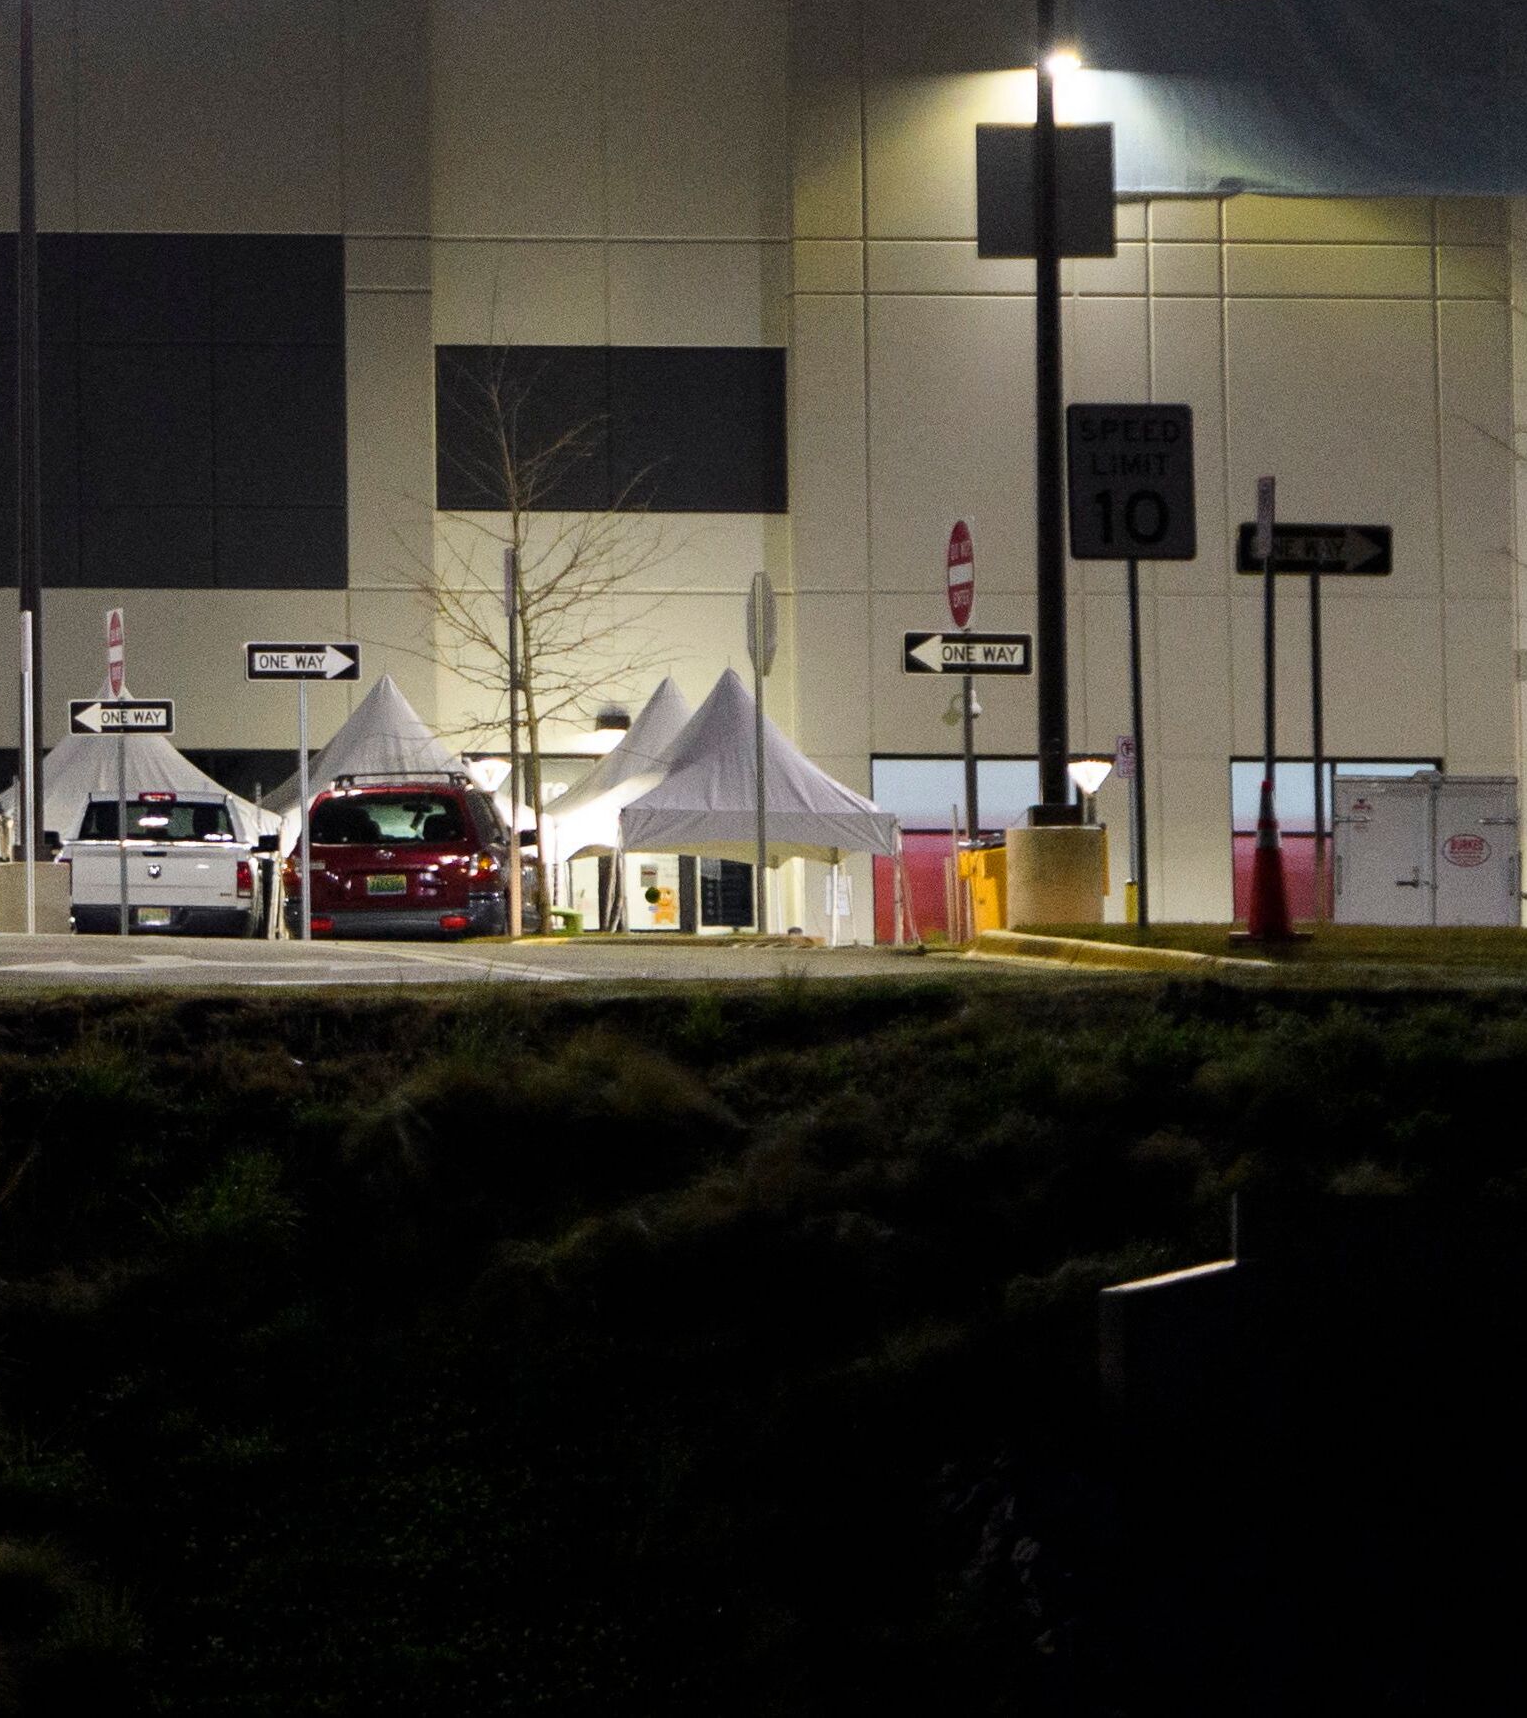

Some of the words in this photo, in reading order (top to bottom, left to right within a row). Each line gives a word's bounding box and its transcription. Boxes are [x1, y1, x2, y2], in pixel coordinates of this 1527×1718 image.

[1080, 420, 1180, 443] SPEED
[1093, 453, 1167, 475] LIMIT
[1095, 489, 1168, 545] 10
[259, 654, 289, 669] ONE
[295, 654, 326, 669] WAY
[942, 645, 976, 662] ONE
[983, 645, 1019, 662] WAY
[101, 711, 128, 725] ONE
[134, 710, 162, 724] WAY
